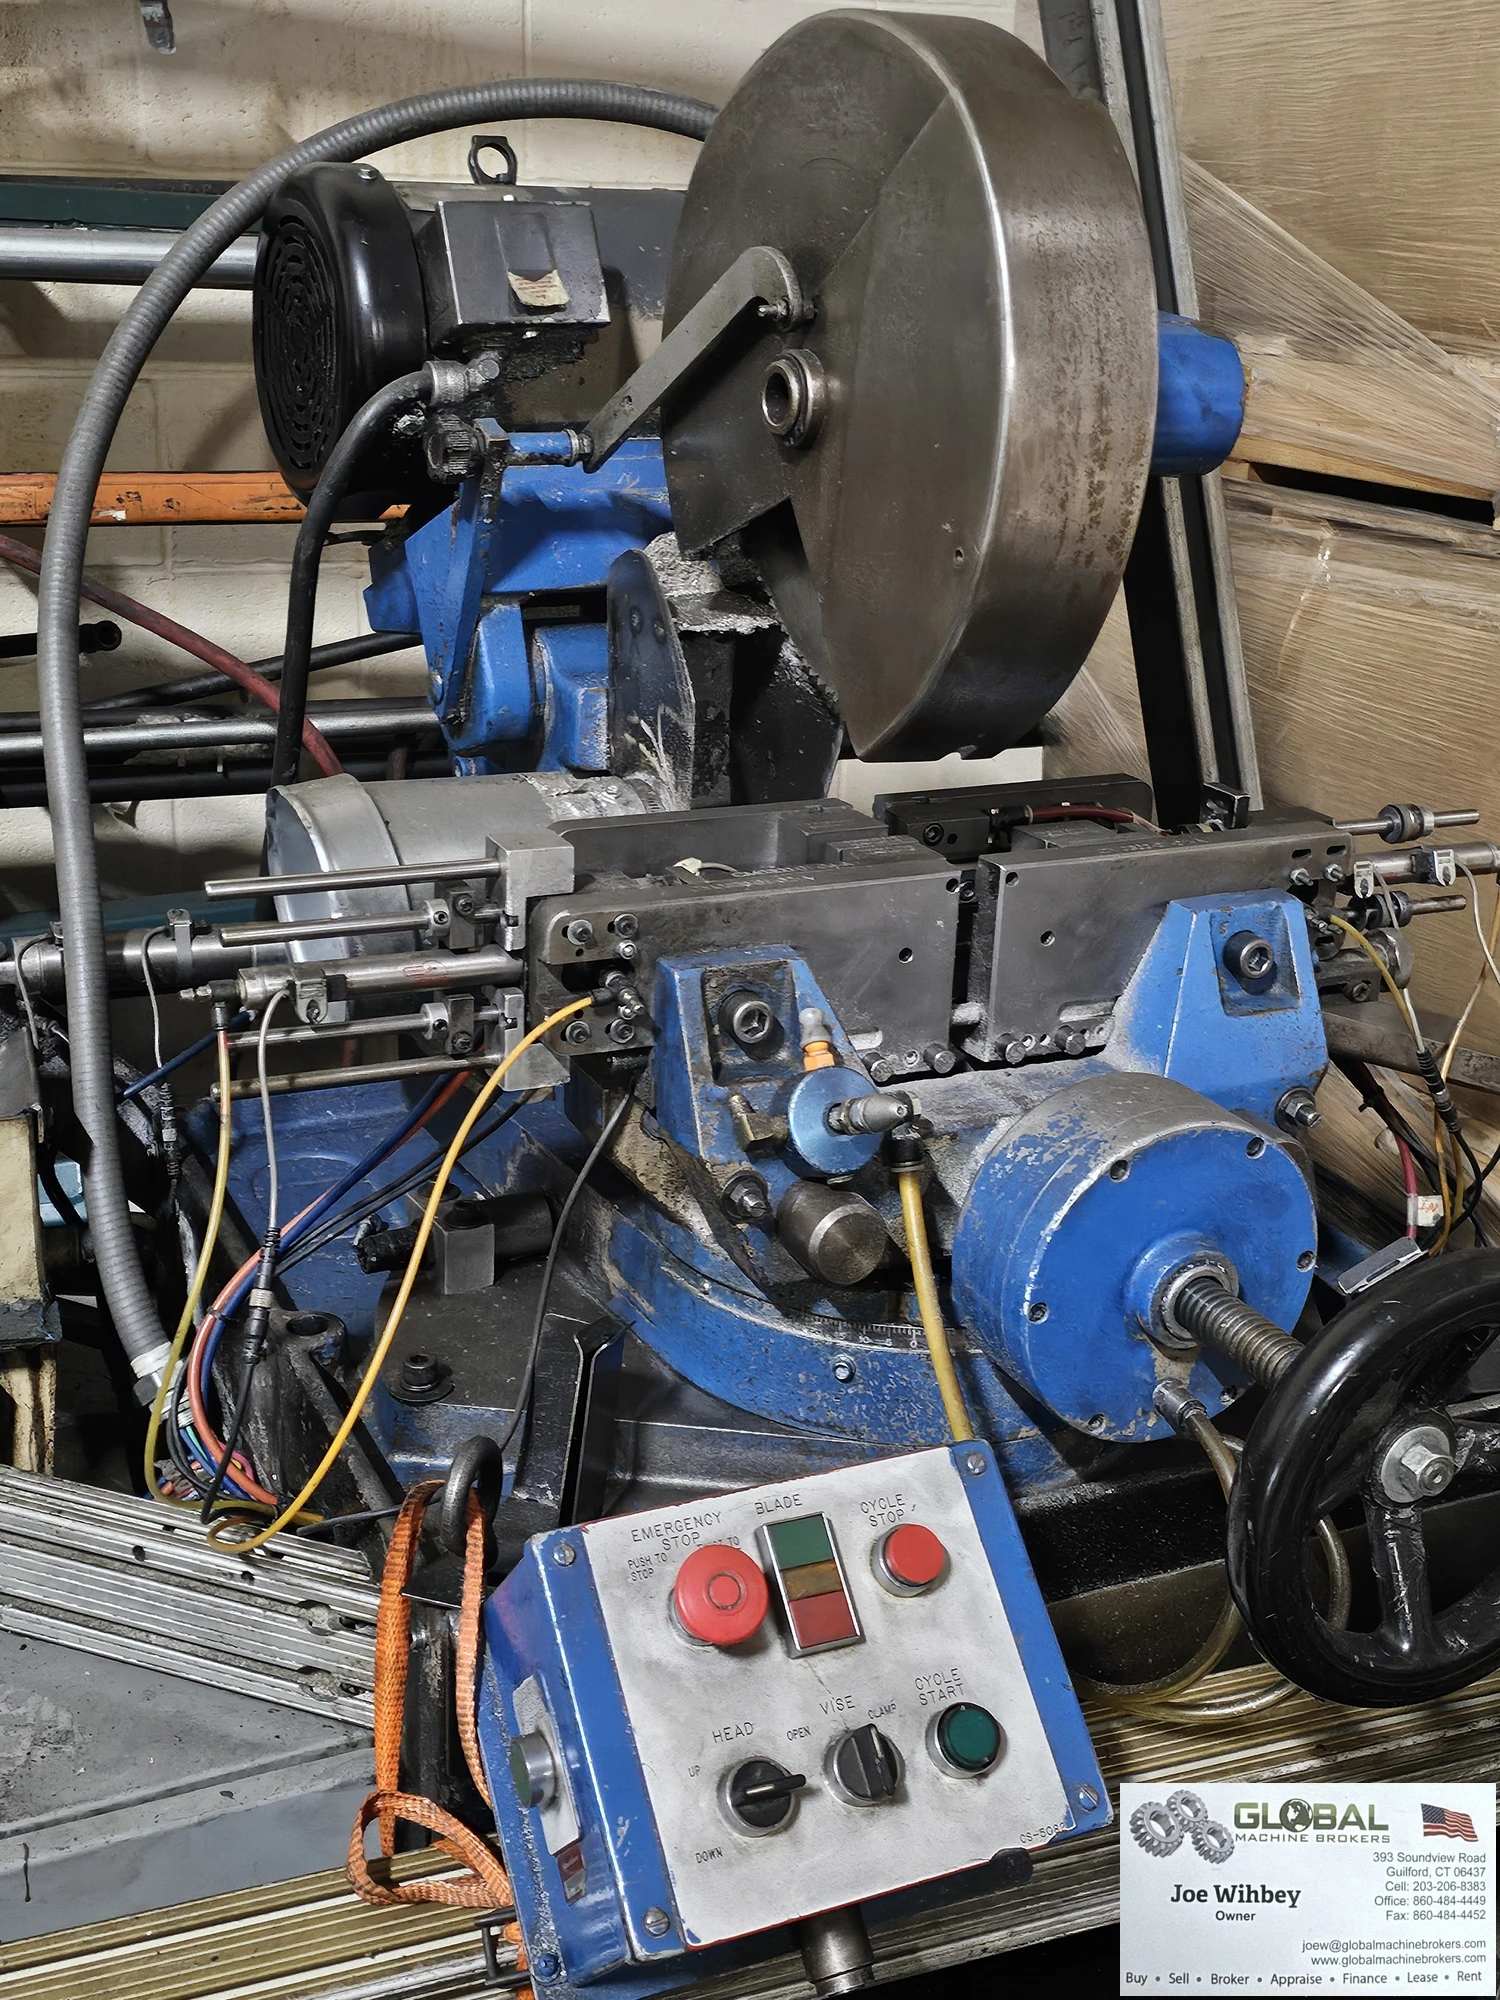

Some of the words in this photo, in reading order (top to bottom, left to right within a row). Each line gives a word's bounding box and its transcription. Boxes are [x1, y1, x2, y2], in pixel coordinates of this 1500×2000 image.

[755, 1494, 802, 1514] BLADE
[860, 1494, 905, 1514] CYCLE
[632, 1511, 722, 1542] EMERGENCY
[868, 1509, 905, 1527] STOP
[662, 1532, 700, 1551] STOP
[628, 1555, 652, 1570] PUSH
[654, 1552, 668, 1564] TO
[631, 1568, 654, 1582] STOP
[914, 1668, 961, 1691] CYCLE
[919, 1683, 965, 1706] START
[819, 1695, 856, 1715] VISE
[868, 1703, 897, 1720] CLAMP
[712, 1722, 754, 1744] HEAD
[786, 1726, 812, 1741] OPEN
[688, 1765, 701, 1778] UP
[695, 1847, 724, 1864] DOWN
